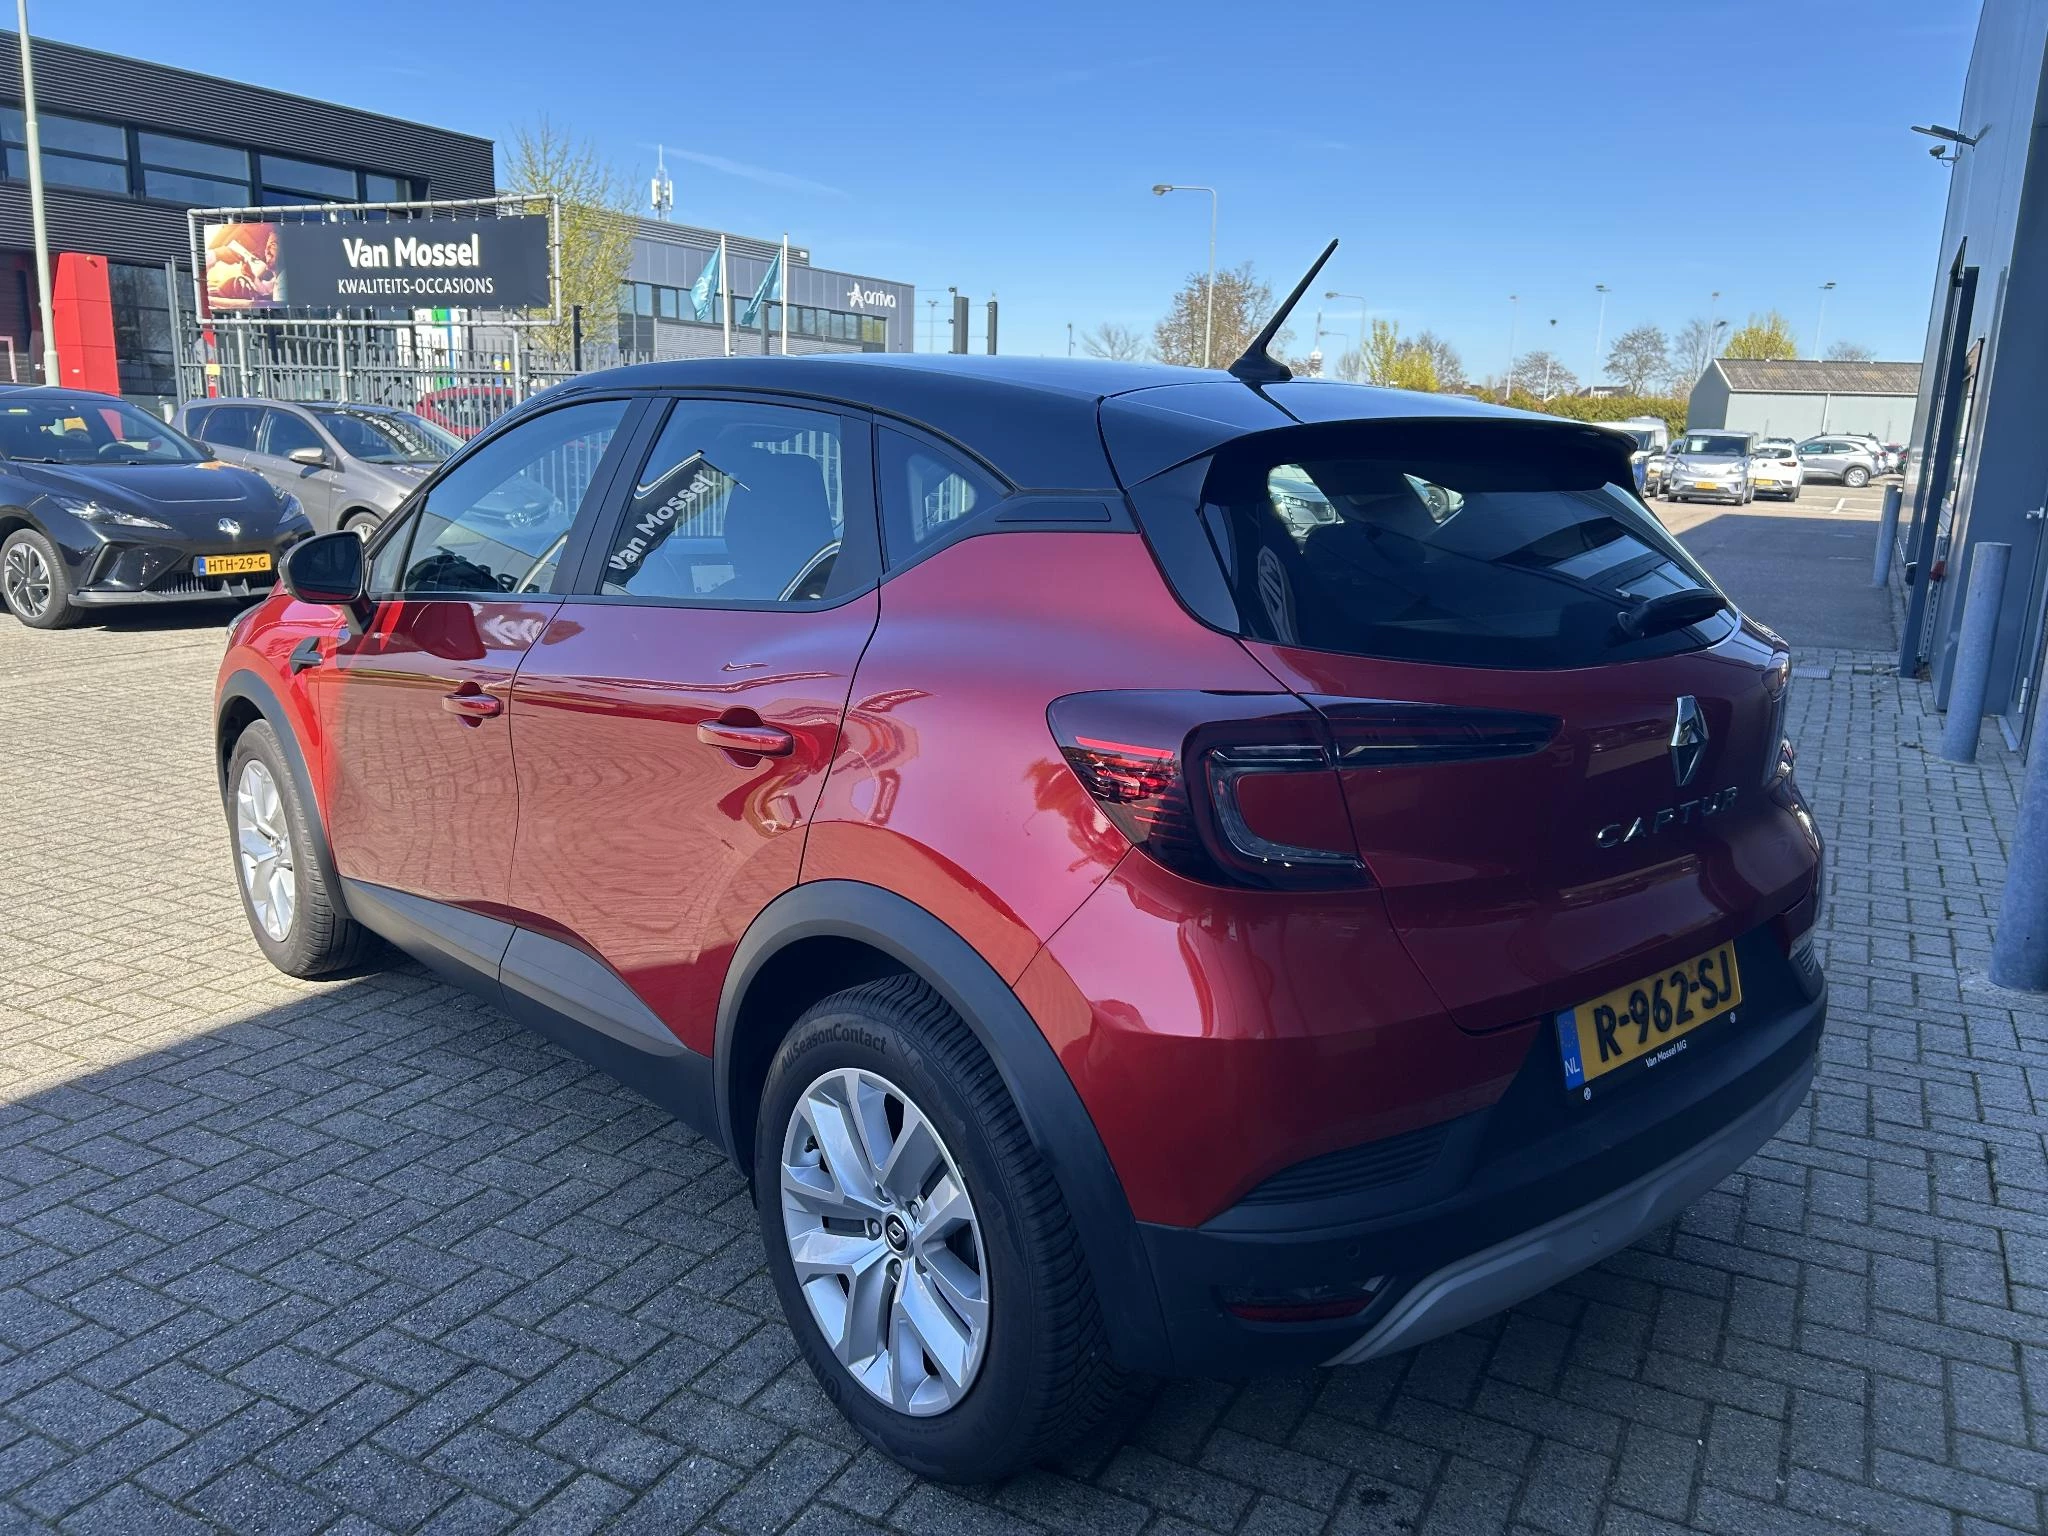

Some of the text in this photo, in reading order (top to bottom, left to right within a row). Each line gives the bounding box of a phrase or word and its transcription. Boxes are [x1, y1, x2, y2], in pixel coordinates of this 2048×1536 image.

[342, 233, 479, 268] Van Mossel
[338, 277, 494, 294] KWALITEITS-OCCASIONS
[608, 473, 715, 570] Van Mossel
[208, 556, 266, 573] HTH-29-G
[1597, 786, 1737, 848] CAPTUR
[1593, 950, 1733, 1063] R-962-SJ
[780, 1022, 888, 1074] AllSeasonContact
[1645, 1056, 1657, 1068] Van
[1656, 1043, 1677, 1063] Mossel
[1564, 1057, 1581, 1077] NL
